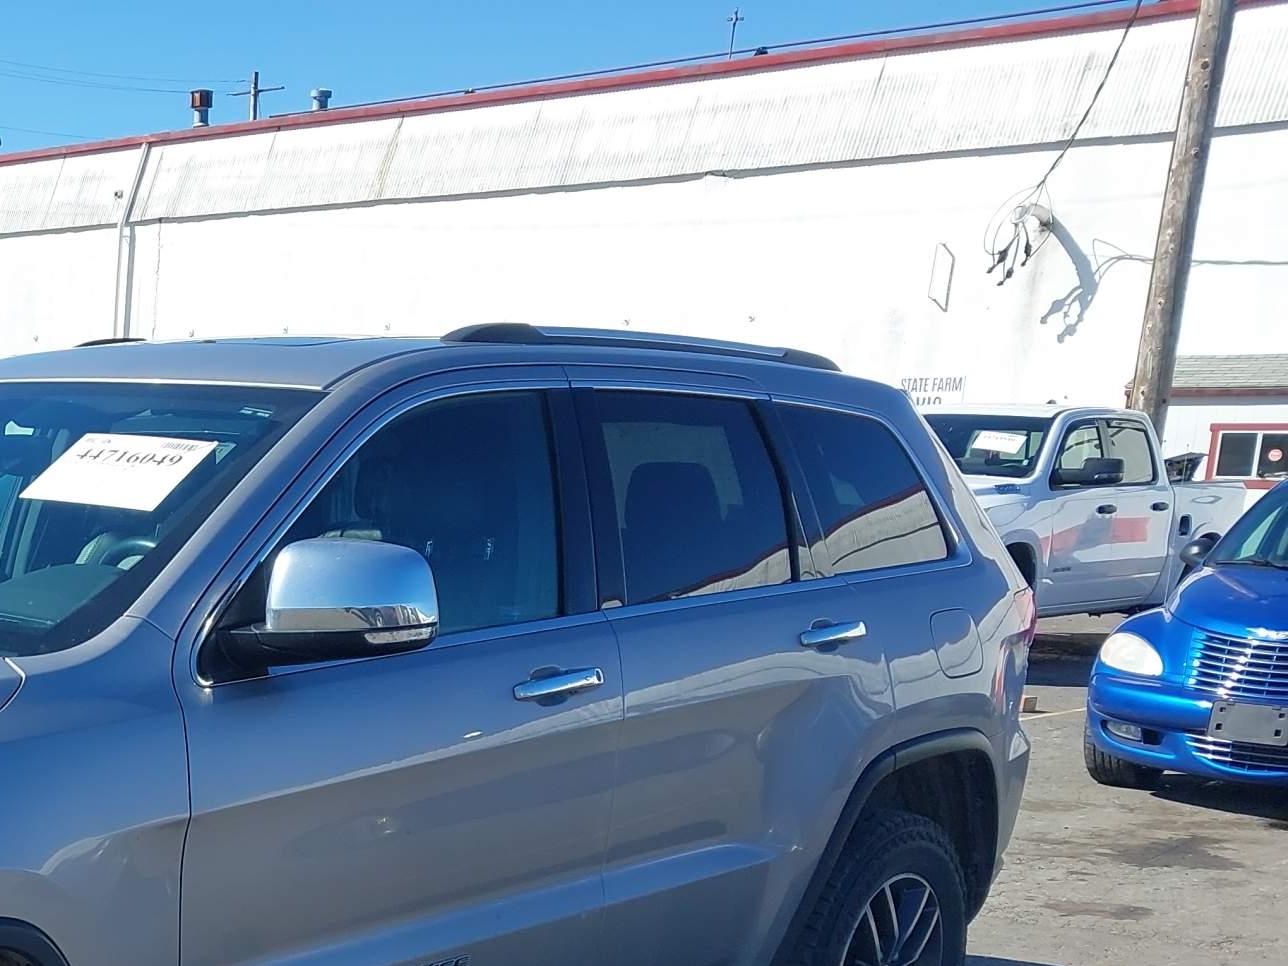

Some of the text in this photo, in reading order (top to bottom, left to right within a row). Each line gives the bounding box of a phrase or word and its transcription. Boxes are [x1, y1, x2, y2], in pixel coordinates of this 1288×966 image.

[901, 376, 963, 393] STATE FARM
[77, 448, 183, 467] 44716049
